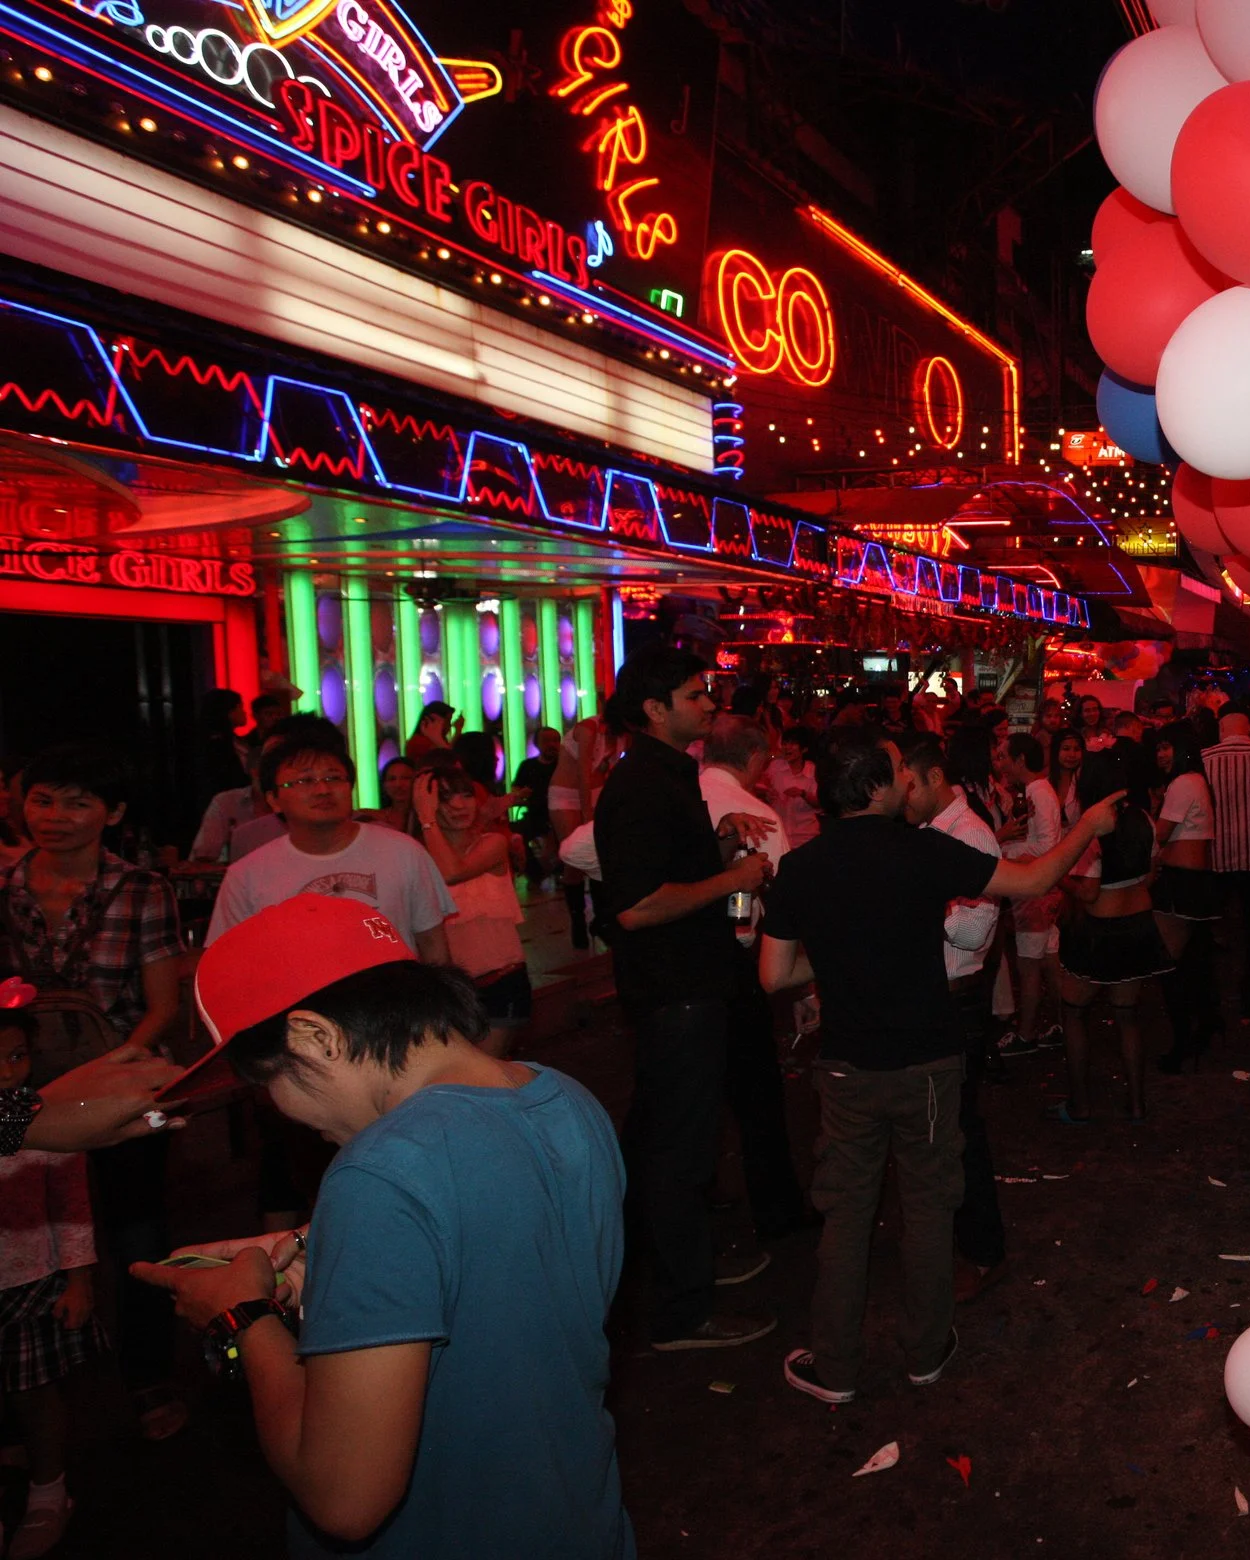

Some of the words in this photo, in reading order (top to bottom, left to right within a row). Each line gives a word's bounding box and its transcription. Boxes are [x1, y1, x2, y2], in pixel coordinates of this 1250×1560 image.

[336, 0, 444, 133] GIRLS
[279, 79, 453, 223] SPICE
[464, 180, 591, 290] GIRLS
[548, 26, 679, 261] GIRLS
[1098, 445, 1126, 458] ATM
[109, 549, 257, 597] GIRLS
[362, 916, 399, 944] NY
